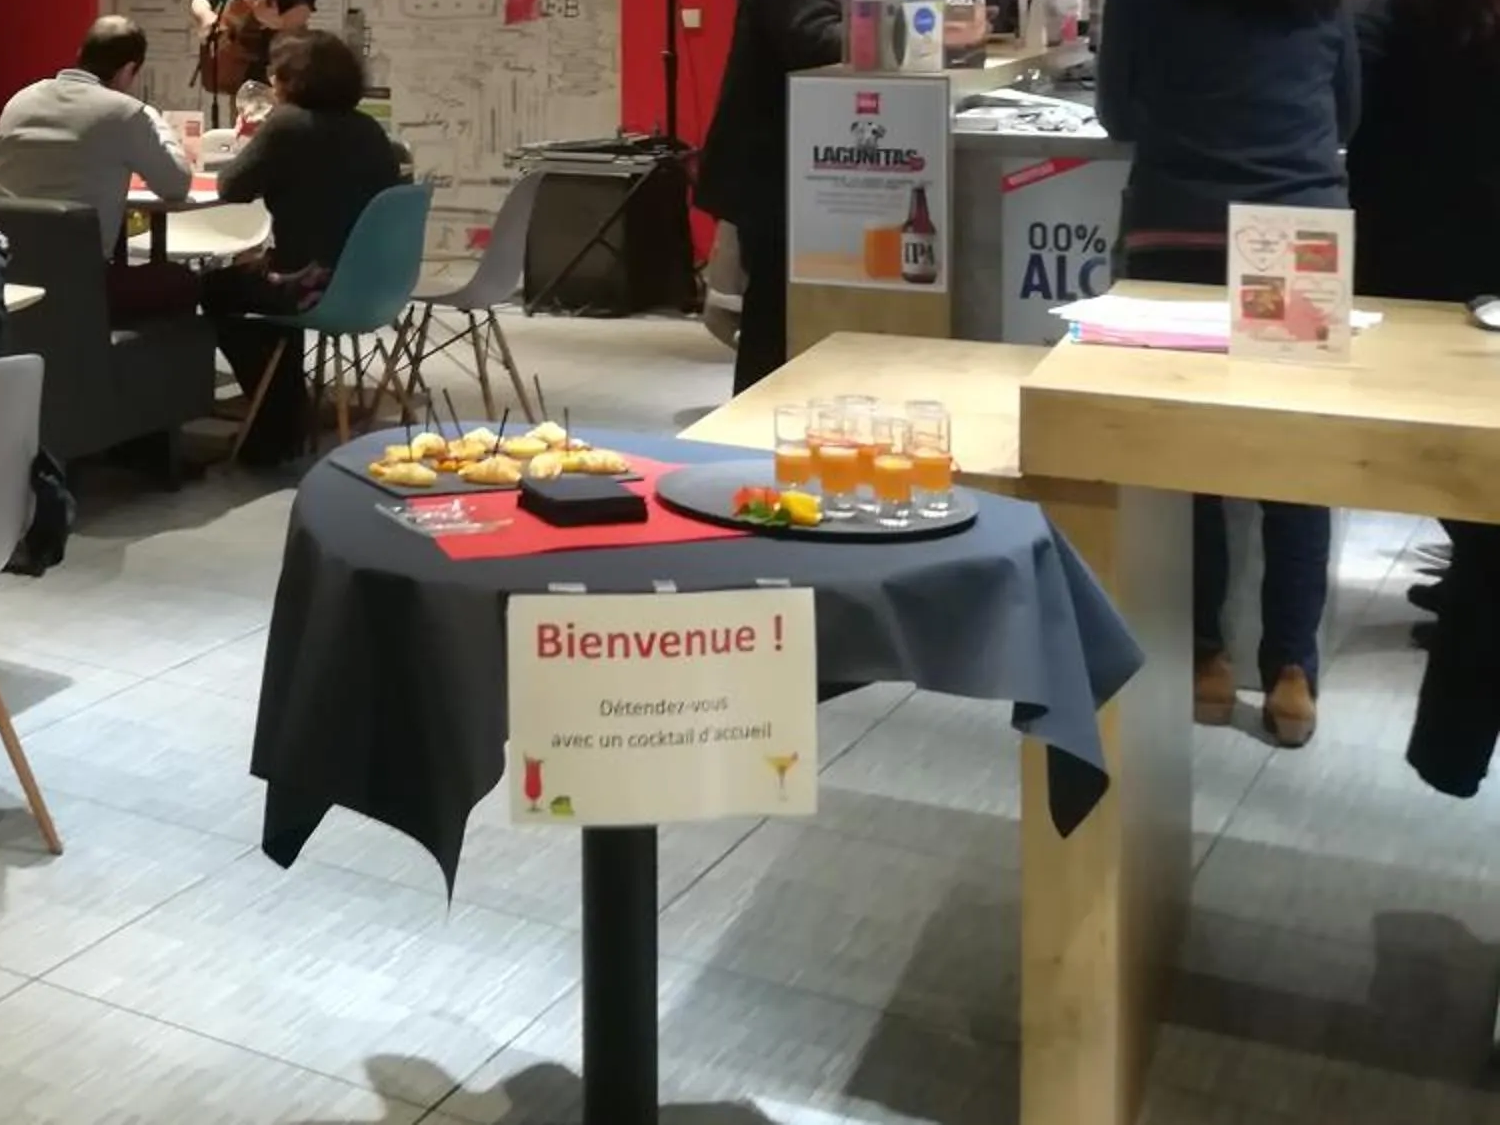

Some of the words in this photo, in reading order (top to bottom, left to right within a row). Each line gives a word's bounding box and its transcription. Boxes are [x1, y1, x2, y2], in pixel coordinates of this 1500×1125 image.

[904, 242, 935, 267] IPA
[536, 622, 756, 660] Bienvenue
[773, 614, 784, 652] !
[550, 733, 593, 749] avec
[599, 734, 623, 748] un
[627, 726, 695, 748] cocktail
